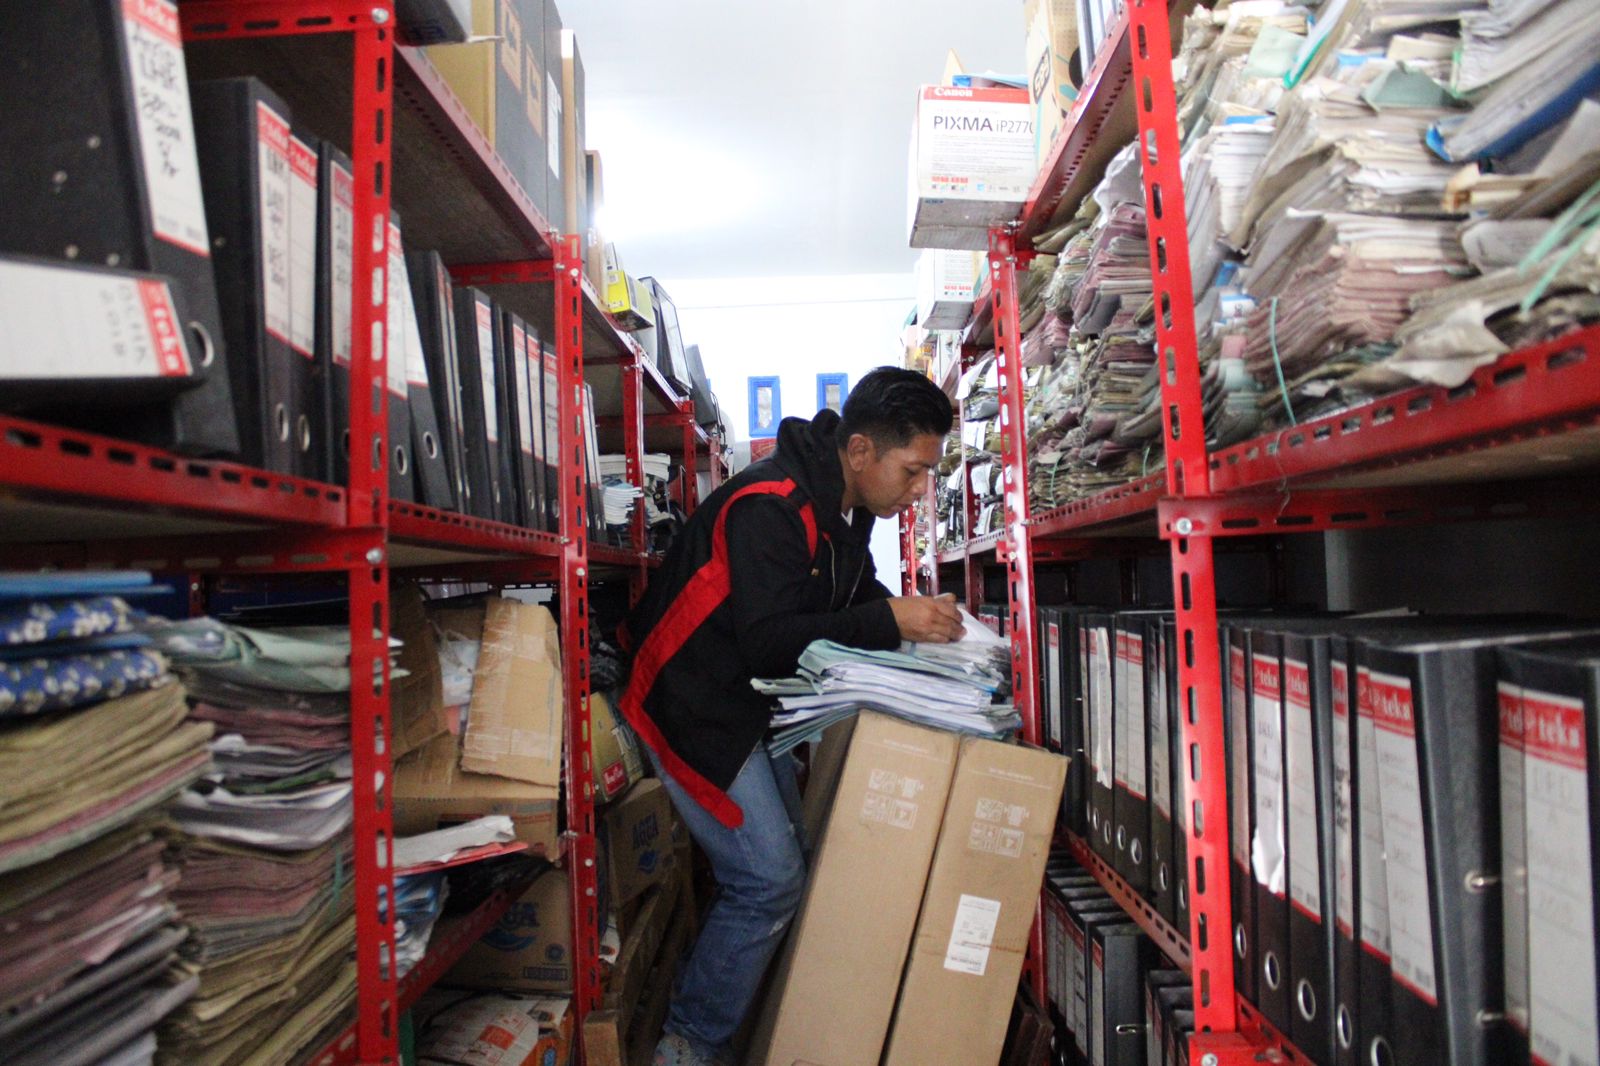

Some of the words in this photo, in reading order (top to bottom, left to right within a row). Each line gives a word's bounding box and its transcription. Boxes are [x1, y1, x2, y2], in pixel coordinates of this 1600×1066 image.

[934, 87, 973, 97] Canon
[933, 115, 993, 132] PIXMA
[153, 308, 180, 371] teka
[1260, 668, 1278, 688] teka
[1382, 690, 1411, 720] teka
[1539, 711, 1580, 748] teka
